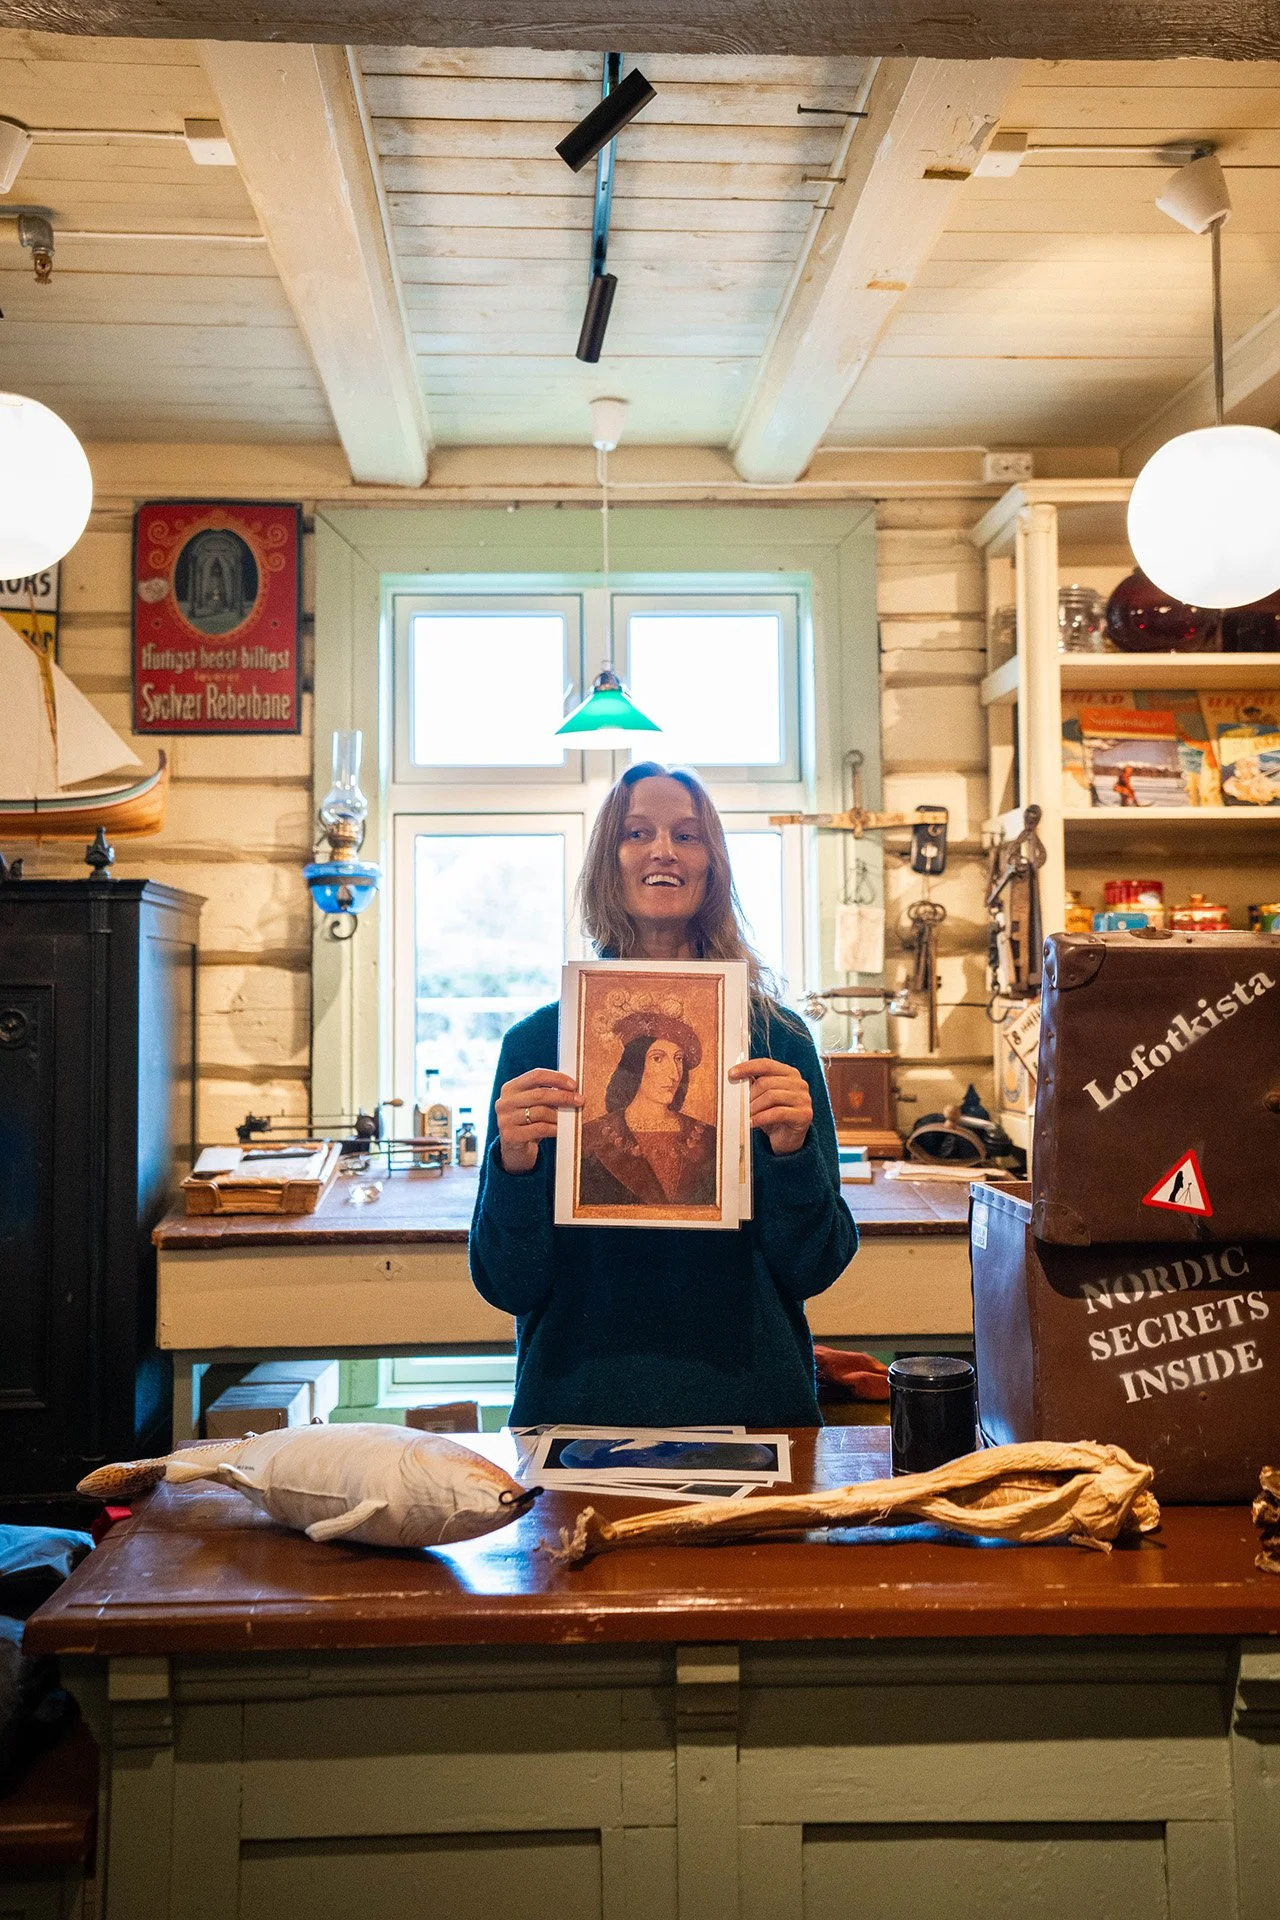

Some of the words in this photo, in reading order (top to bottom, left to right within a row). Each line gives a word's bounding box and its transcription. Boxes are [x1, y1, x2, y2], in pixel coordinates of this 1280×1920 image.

[241, 646, 290, 673] billigst
[206, 683, 290, 720] Reberbane
[1083, 972, 1276, 1111] Lofotkista
[1080, 1246, 1249, 1314] NORDIC
[1088, 1291, 1269, 1361] SECRETS
[1120, 1340, 1263, 1404] INSIDE
